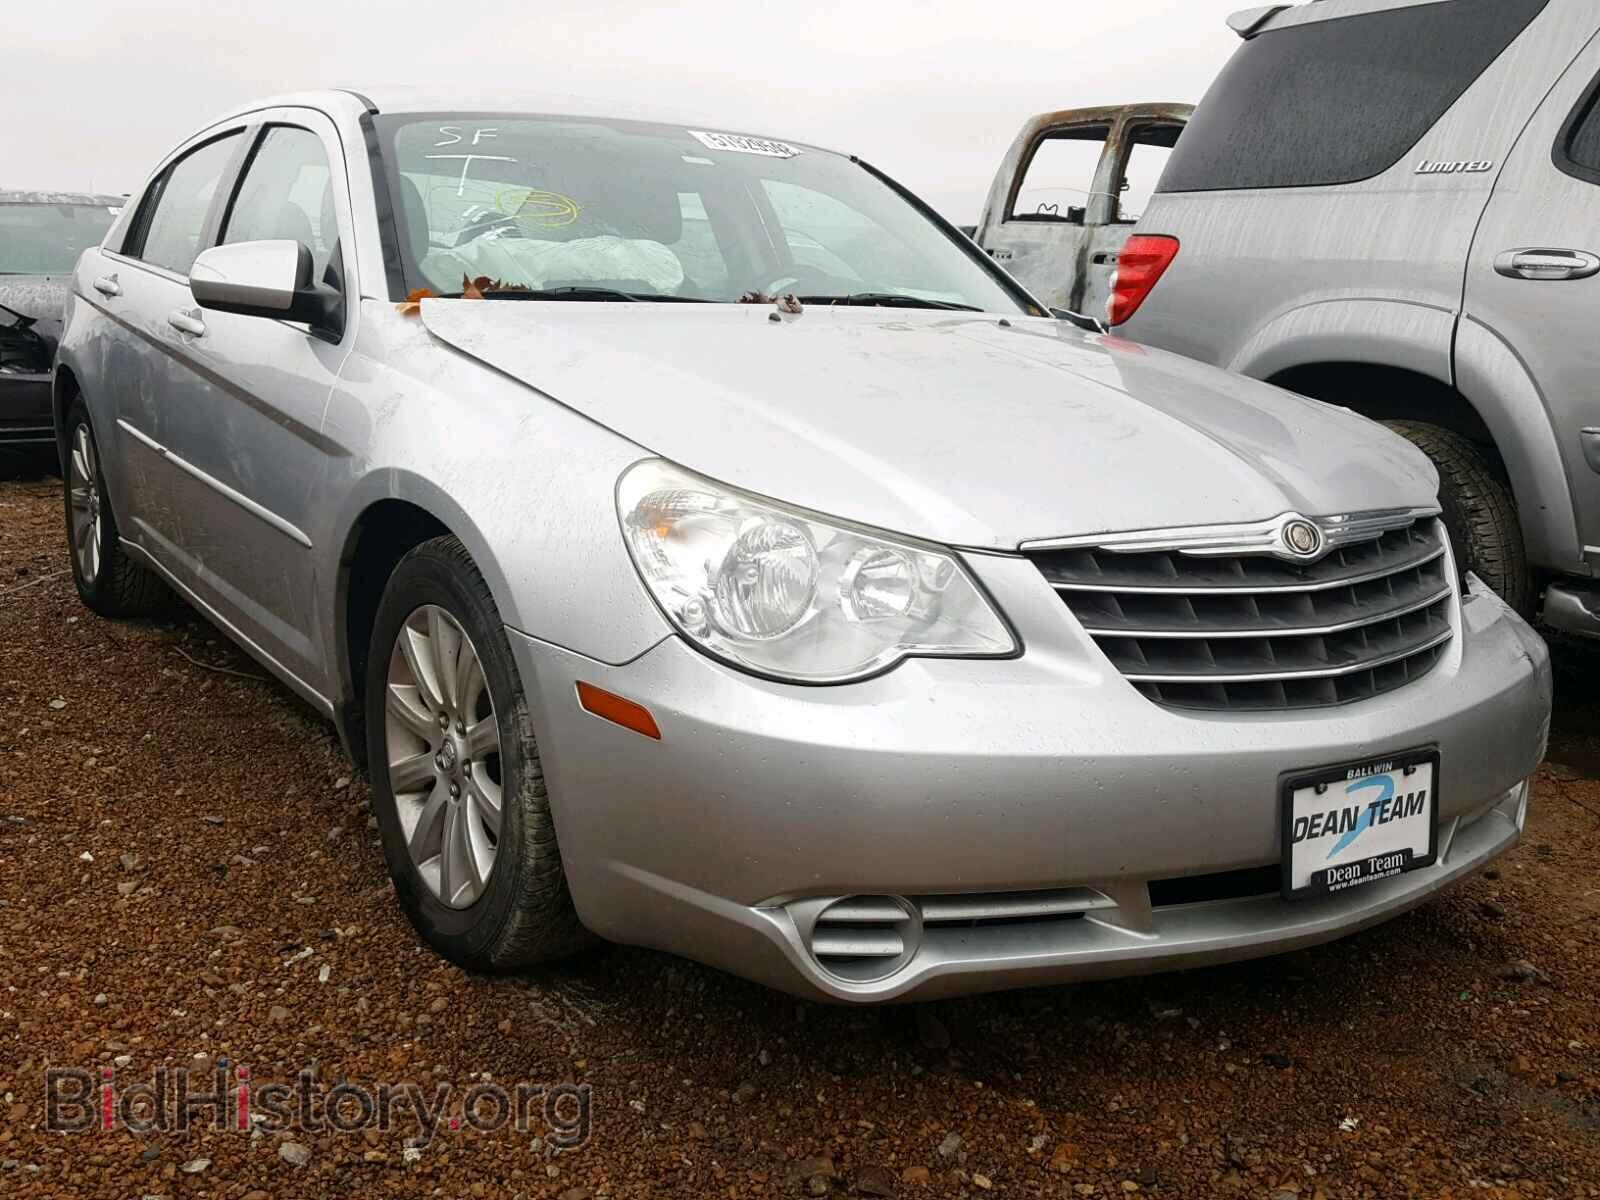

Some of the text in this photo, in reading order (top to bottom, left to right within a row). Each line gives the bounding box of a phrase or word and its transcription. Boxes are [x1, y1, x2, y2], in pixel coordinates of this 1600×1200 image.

[1414, 160, 1494, 175] LIMITED
[1346, 761, 1393, 780] BALLWIN
[1292, 790, 1426, 844] DEAN TEAM
[1326, 853, 1404, 885] Dean Team
[1328, 867, 1401, 892] www.deanteam.com
